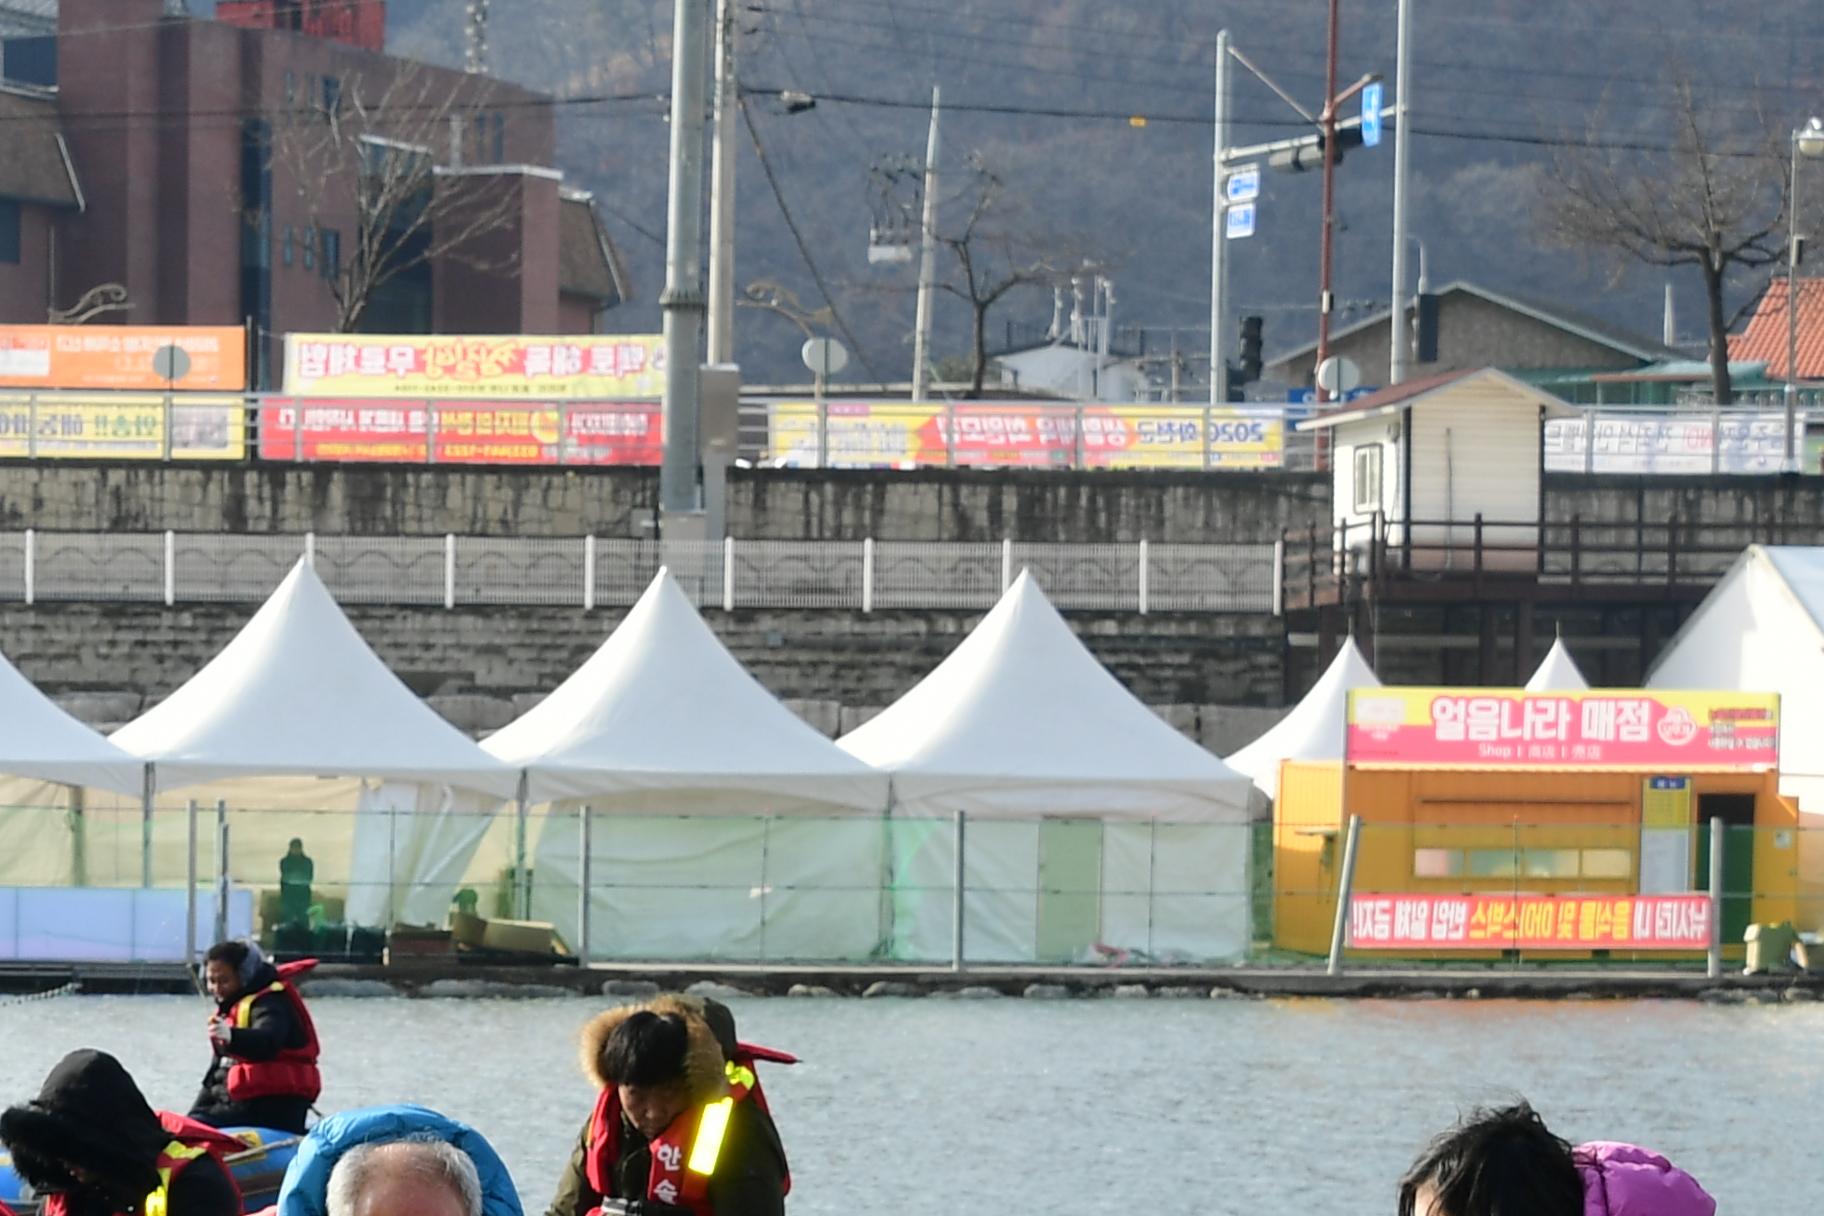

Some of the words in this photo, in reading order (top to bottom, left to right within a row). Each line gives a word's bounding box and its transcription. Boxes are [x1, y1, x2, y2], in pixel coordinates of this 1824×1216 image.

[1432, 697, 1570, 742] 얼음나라
[1581, 698, 1650, 742] 매점
[1478, 743, 1512, 760] Shop
